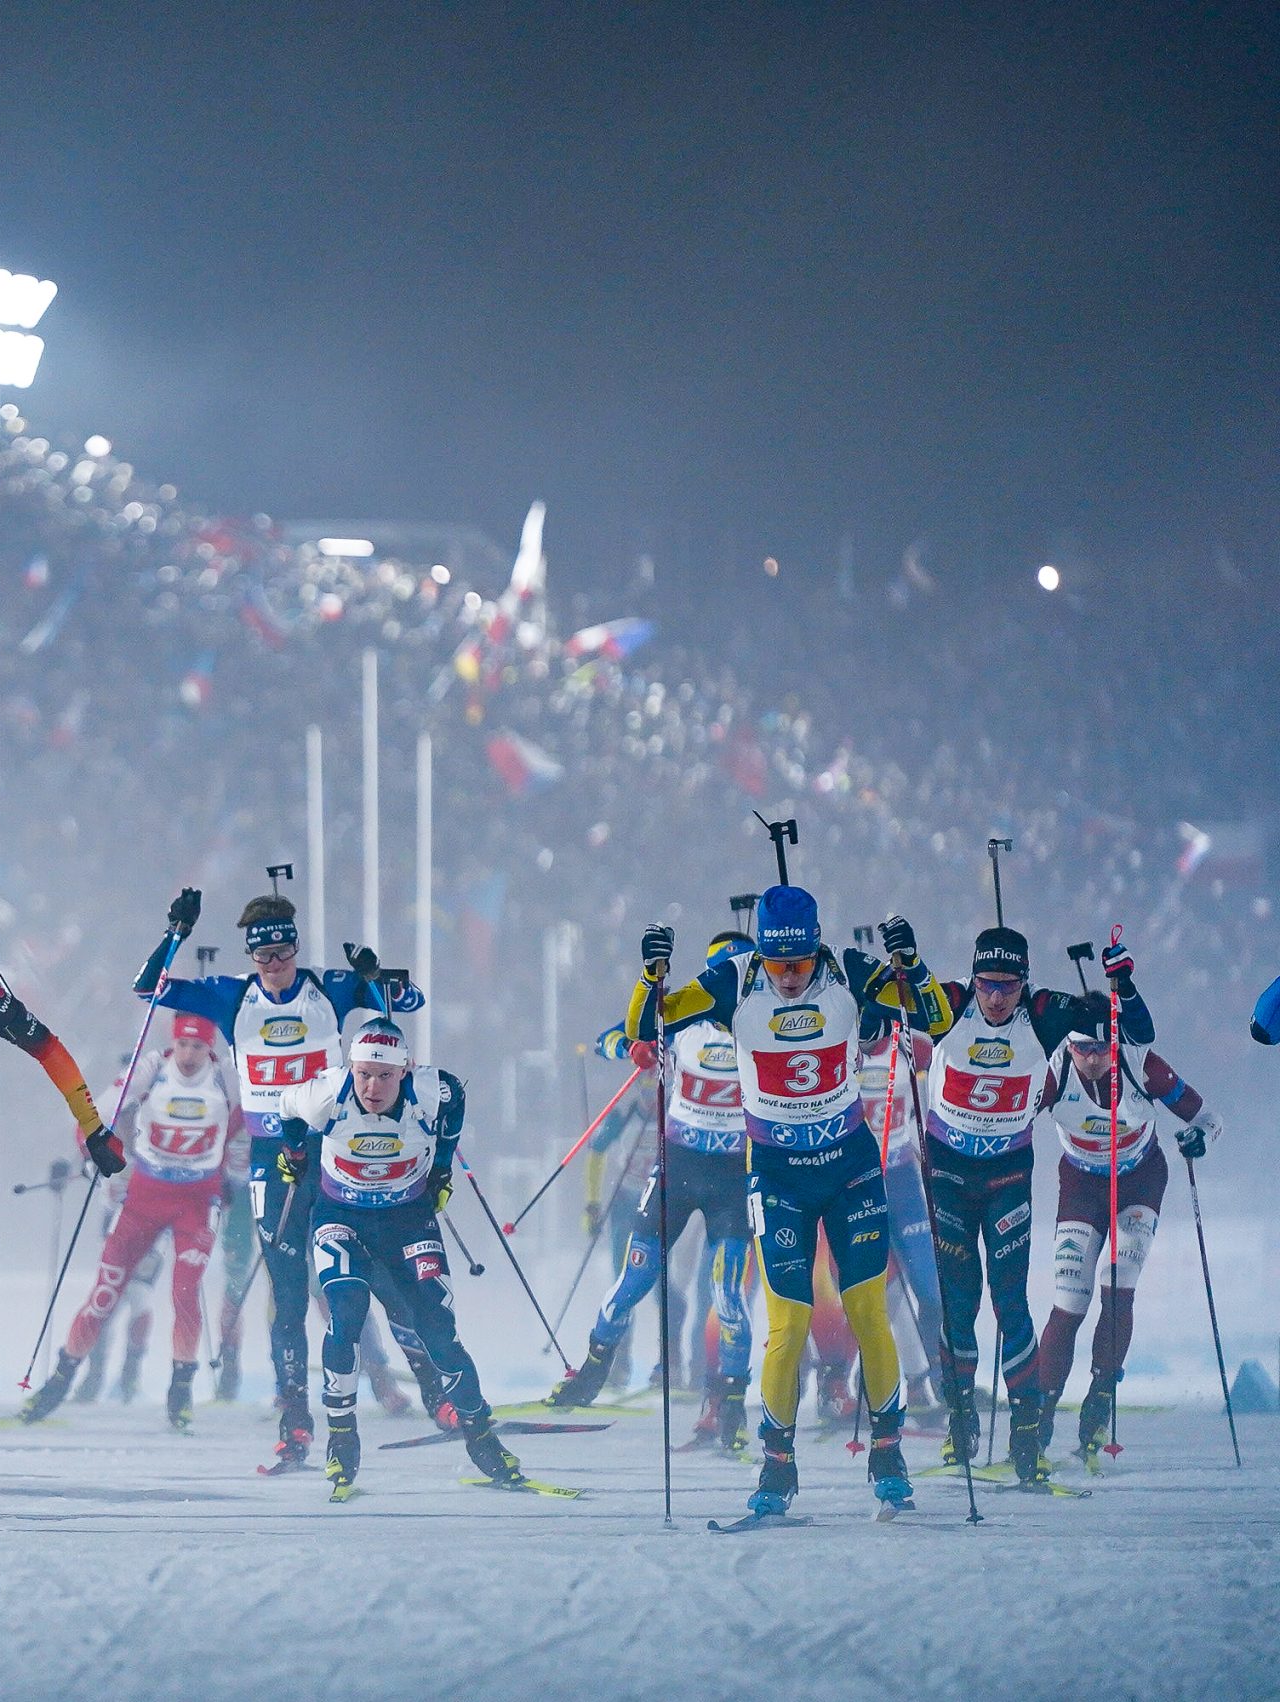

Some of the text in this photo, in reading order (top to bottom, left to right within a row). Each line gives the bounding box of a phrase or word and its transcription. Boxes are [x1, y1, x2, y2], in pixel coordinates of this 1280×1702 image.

[358, 1033, 401, 1048] AVANT
[256, 1056, 306, 1082] 11
[786, 1053, 821, 1093] 3
[833, 1061, 844, 1084] 1
[267, 1088, 282, 1097] MĚST
[970, 1077, 1003, 1108] 5
[1012, 1091, 1024, 1109] 1
[758, 1096, 778, 1109] NOVÉ
[779, 1100, 809, 1110] MĚSTO
[810, 1099, 822, 1108] NA
[983, 1114, 995, 1123] NA
[808, 1115, 849, 1147] iX2
[706, 1132, 741, 1151] iX2
[973, 1136, 1010, 1156] iX2
[847, 1203, 888, 1223] SVEASKO
[850, 1230, 880, 1246] ATG
[418, 1260, 440, 1275] Rex
